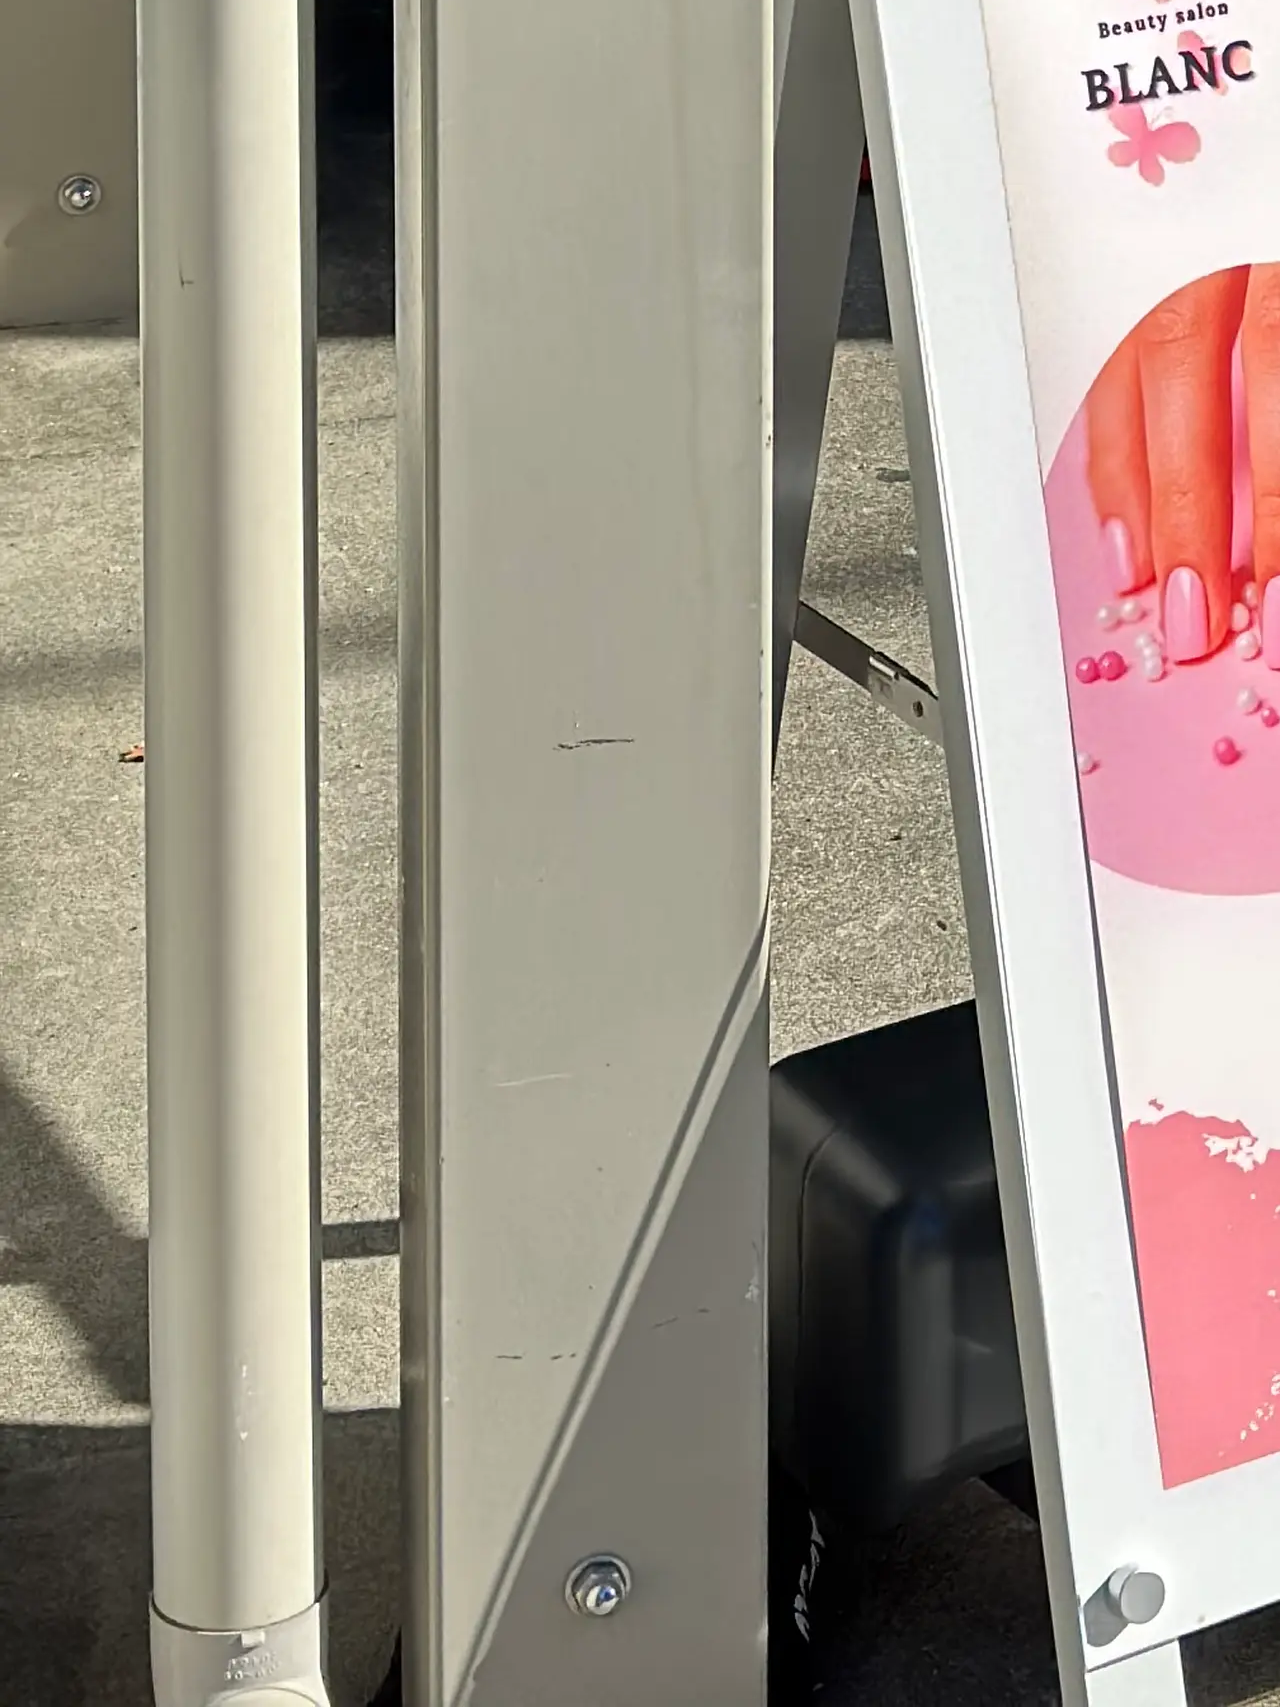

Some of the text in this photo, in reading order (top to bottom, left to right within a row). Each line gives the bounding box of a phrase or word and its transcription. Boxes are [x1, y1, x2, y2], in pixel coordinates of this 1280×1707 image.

[1098, 1, 1230, 38] Beauty salon
[1081, 40, 1257, 111] BLANC
